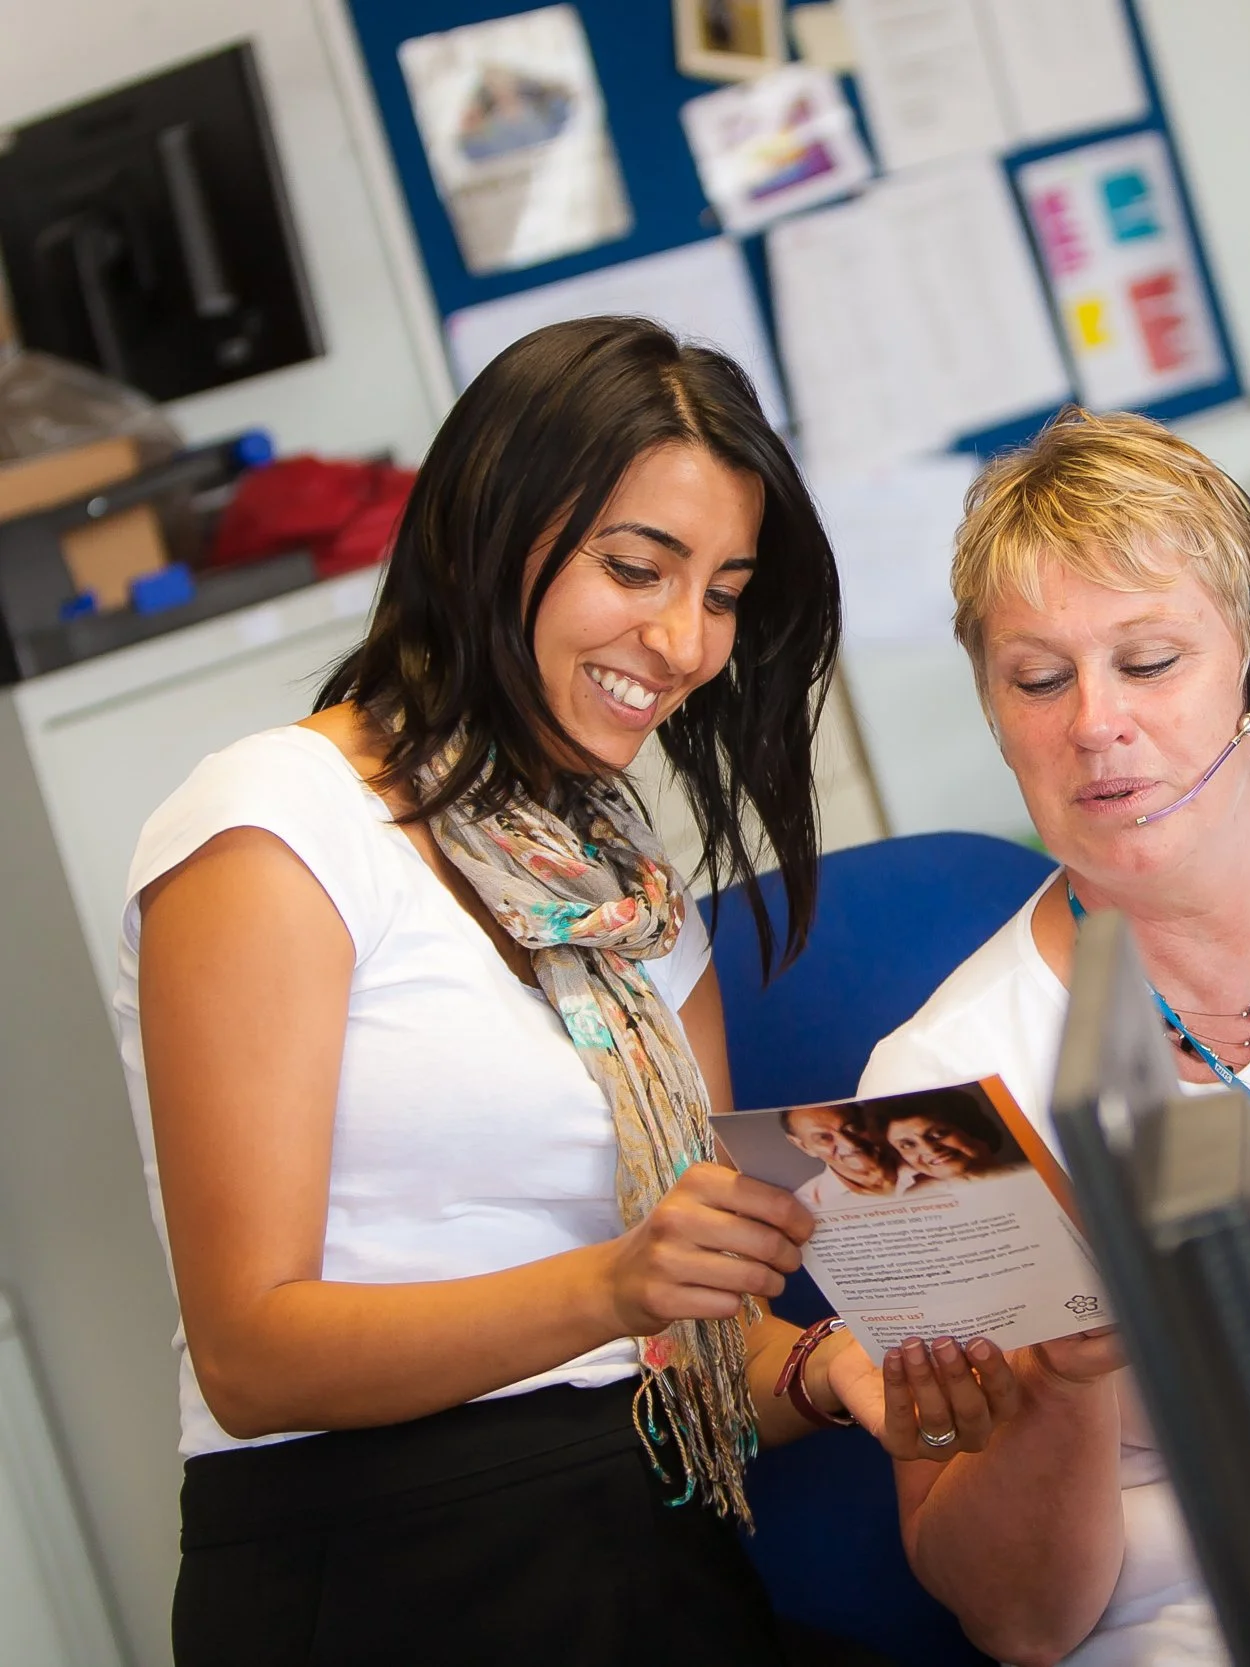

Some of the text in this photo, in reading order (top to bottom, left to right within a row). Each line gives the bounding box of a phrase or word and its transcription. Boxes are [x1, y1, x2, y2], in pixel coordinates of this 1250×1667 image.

[1215, 1064, 1231, 1082] NHS
[841, 1213, 861, 1221] the
[864, 1207, 908, 1218] referral
[910, 1200, 959, 1214] process?
[860, 1312, 925, 1322] Contact us?
[975, 1308, 1009, 1323] practical
